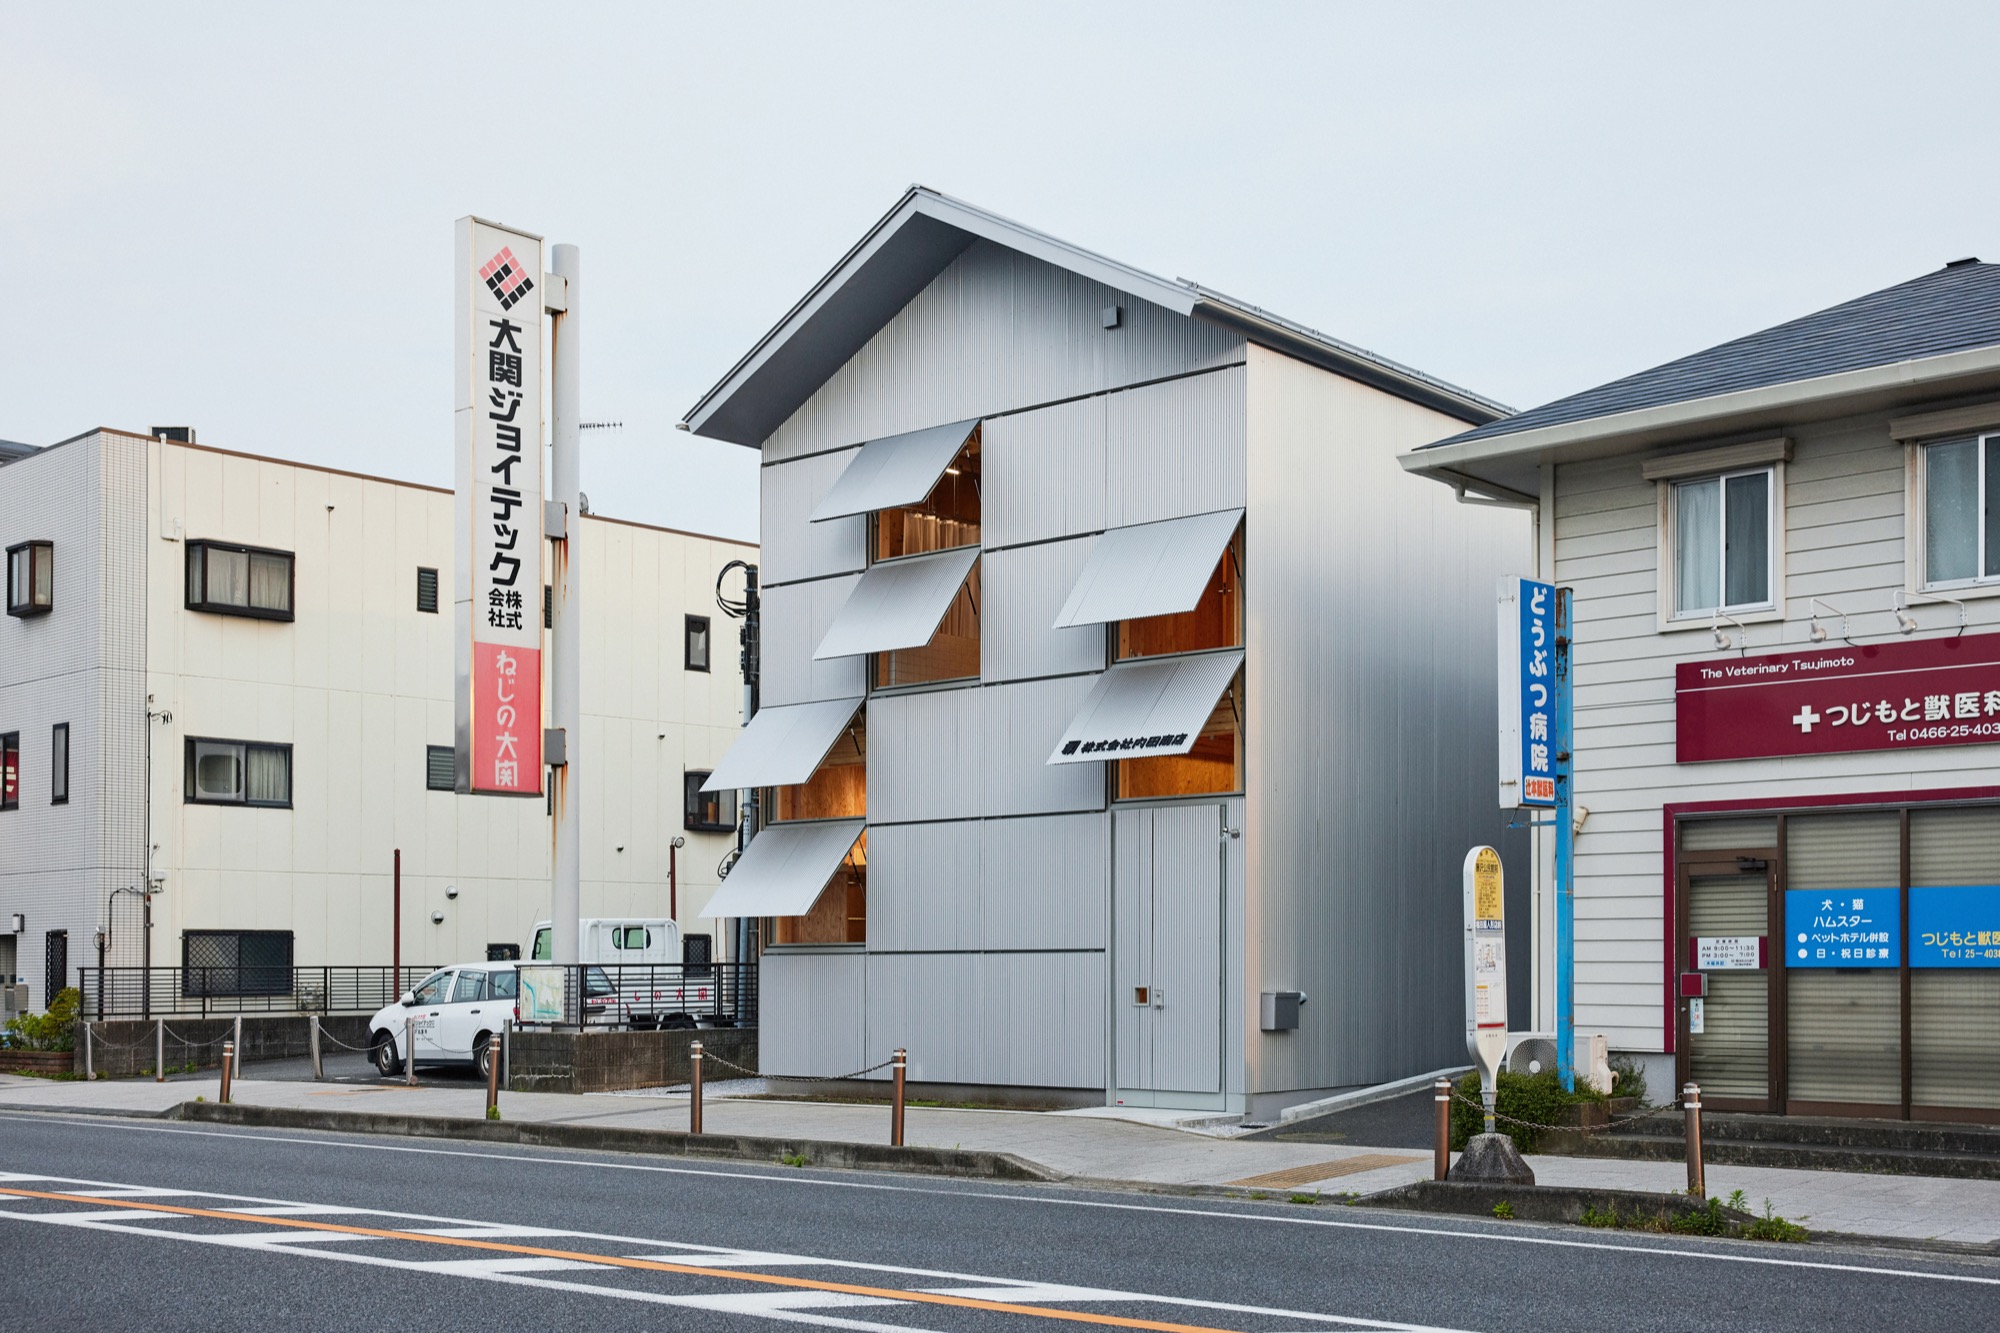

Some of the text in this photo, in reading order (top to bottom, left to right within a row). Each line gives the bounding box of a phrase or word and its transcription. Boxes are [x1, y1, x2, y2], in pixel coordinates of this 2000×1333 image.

[488, 318, 523, 587] 大関ジョイテック
[488, 587, 523, 630] 株式会社
[1529, 586, 1549, 773] どうぶつ病院
[1700, 656, 1855, 680] The Veterinary Tsujimoto
[495, 649, 519, 788] ねじの大関
[1825, 689, 2000, 728] つじもと獣医科
[1080, 732, 1189, 754] 株式会社内田商店
[1887, 729, 1907, 742] Tel
[1813, 915, 1873, 928] ハムスター
[1811, 932, 1889, 943] ペットホテル併設
[1816, 948, 1889, 959] 日・祝日診療
[1941, 948, 1961, 958] Tel
